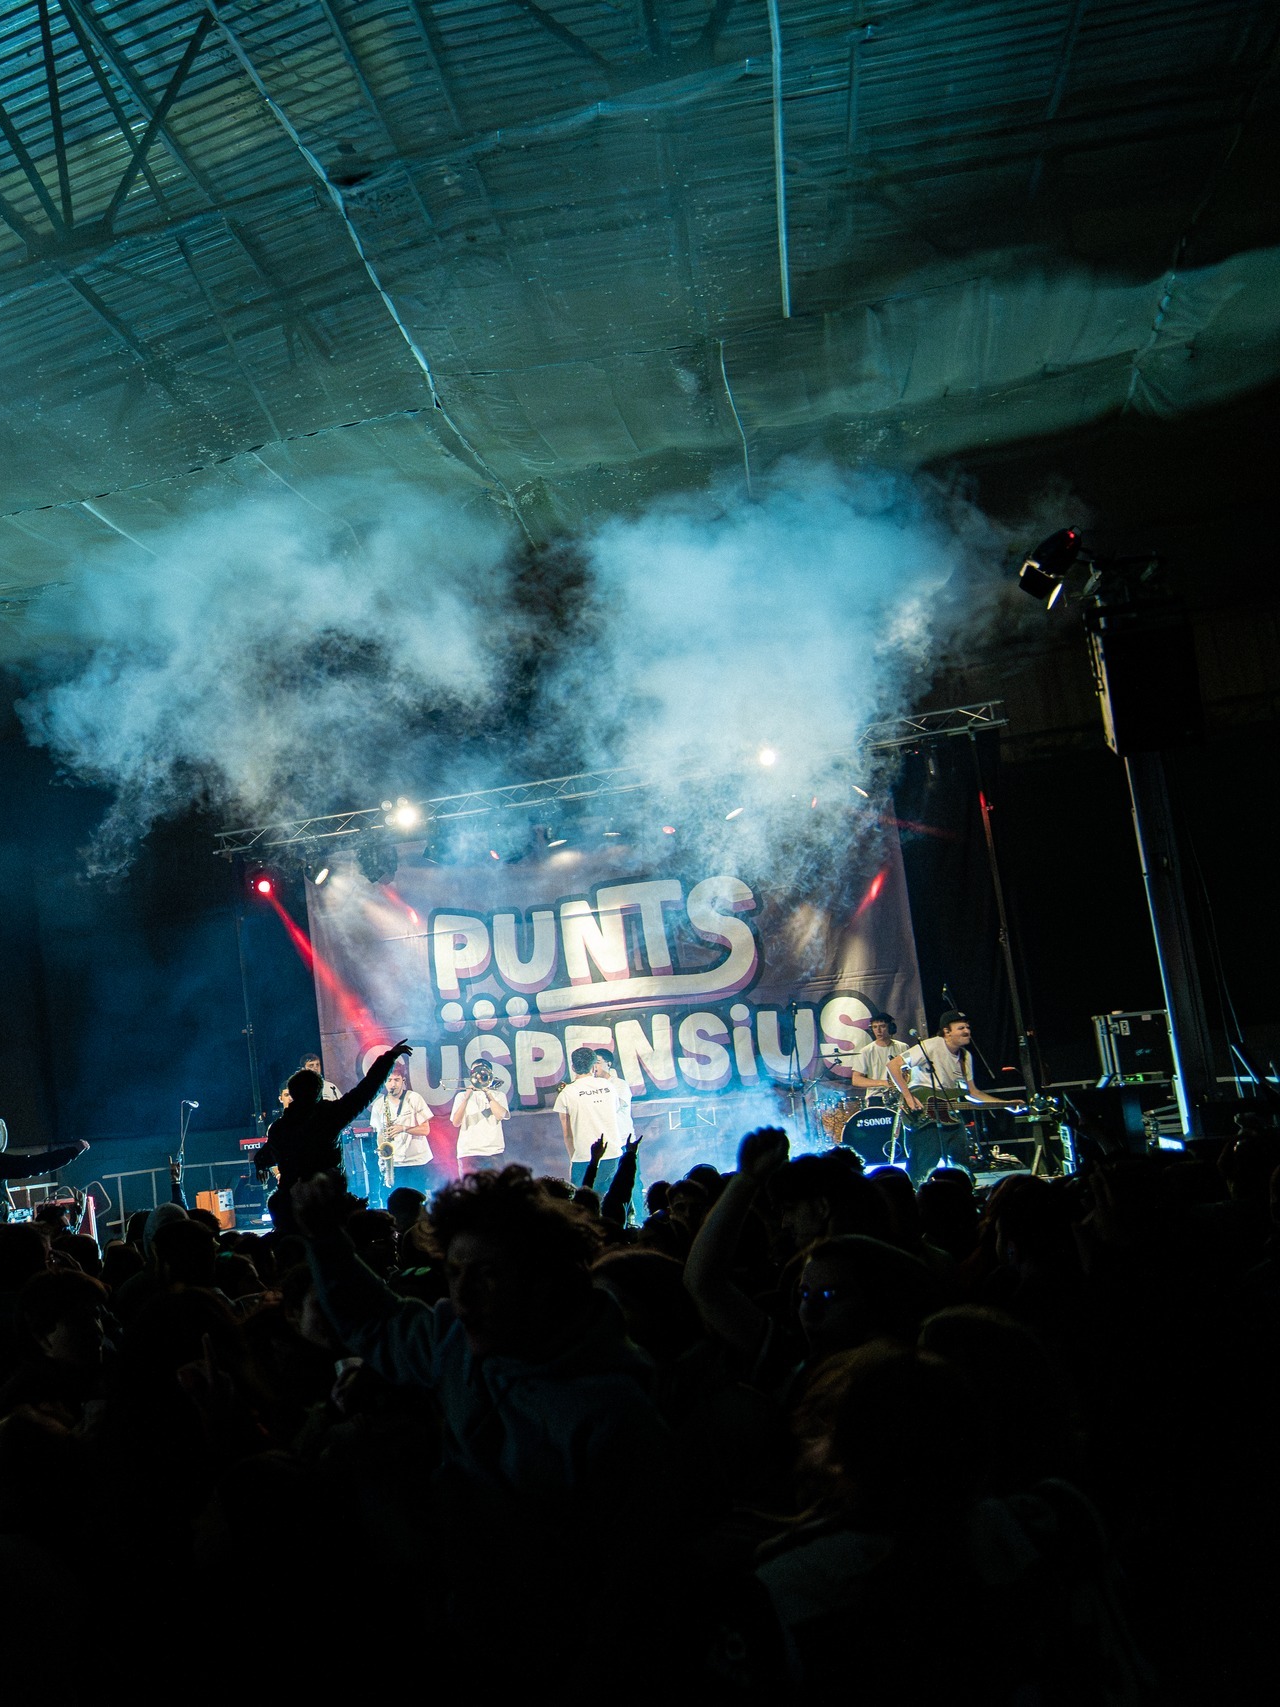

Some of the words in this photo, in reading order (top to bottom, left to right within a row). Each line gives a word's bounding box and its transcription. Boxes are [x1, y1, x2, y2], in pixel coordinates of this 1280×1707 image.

[432, 874, 758, 1020] PUNTS
[362, 996, 876, 1110] USPNSiUS
[578, 1087, 611, 1097] PUNTS
[863, 1117, 892, 1127] SONOR
[243, 1142, 261, 1150] nord
